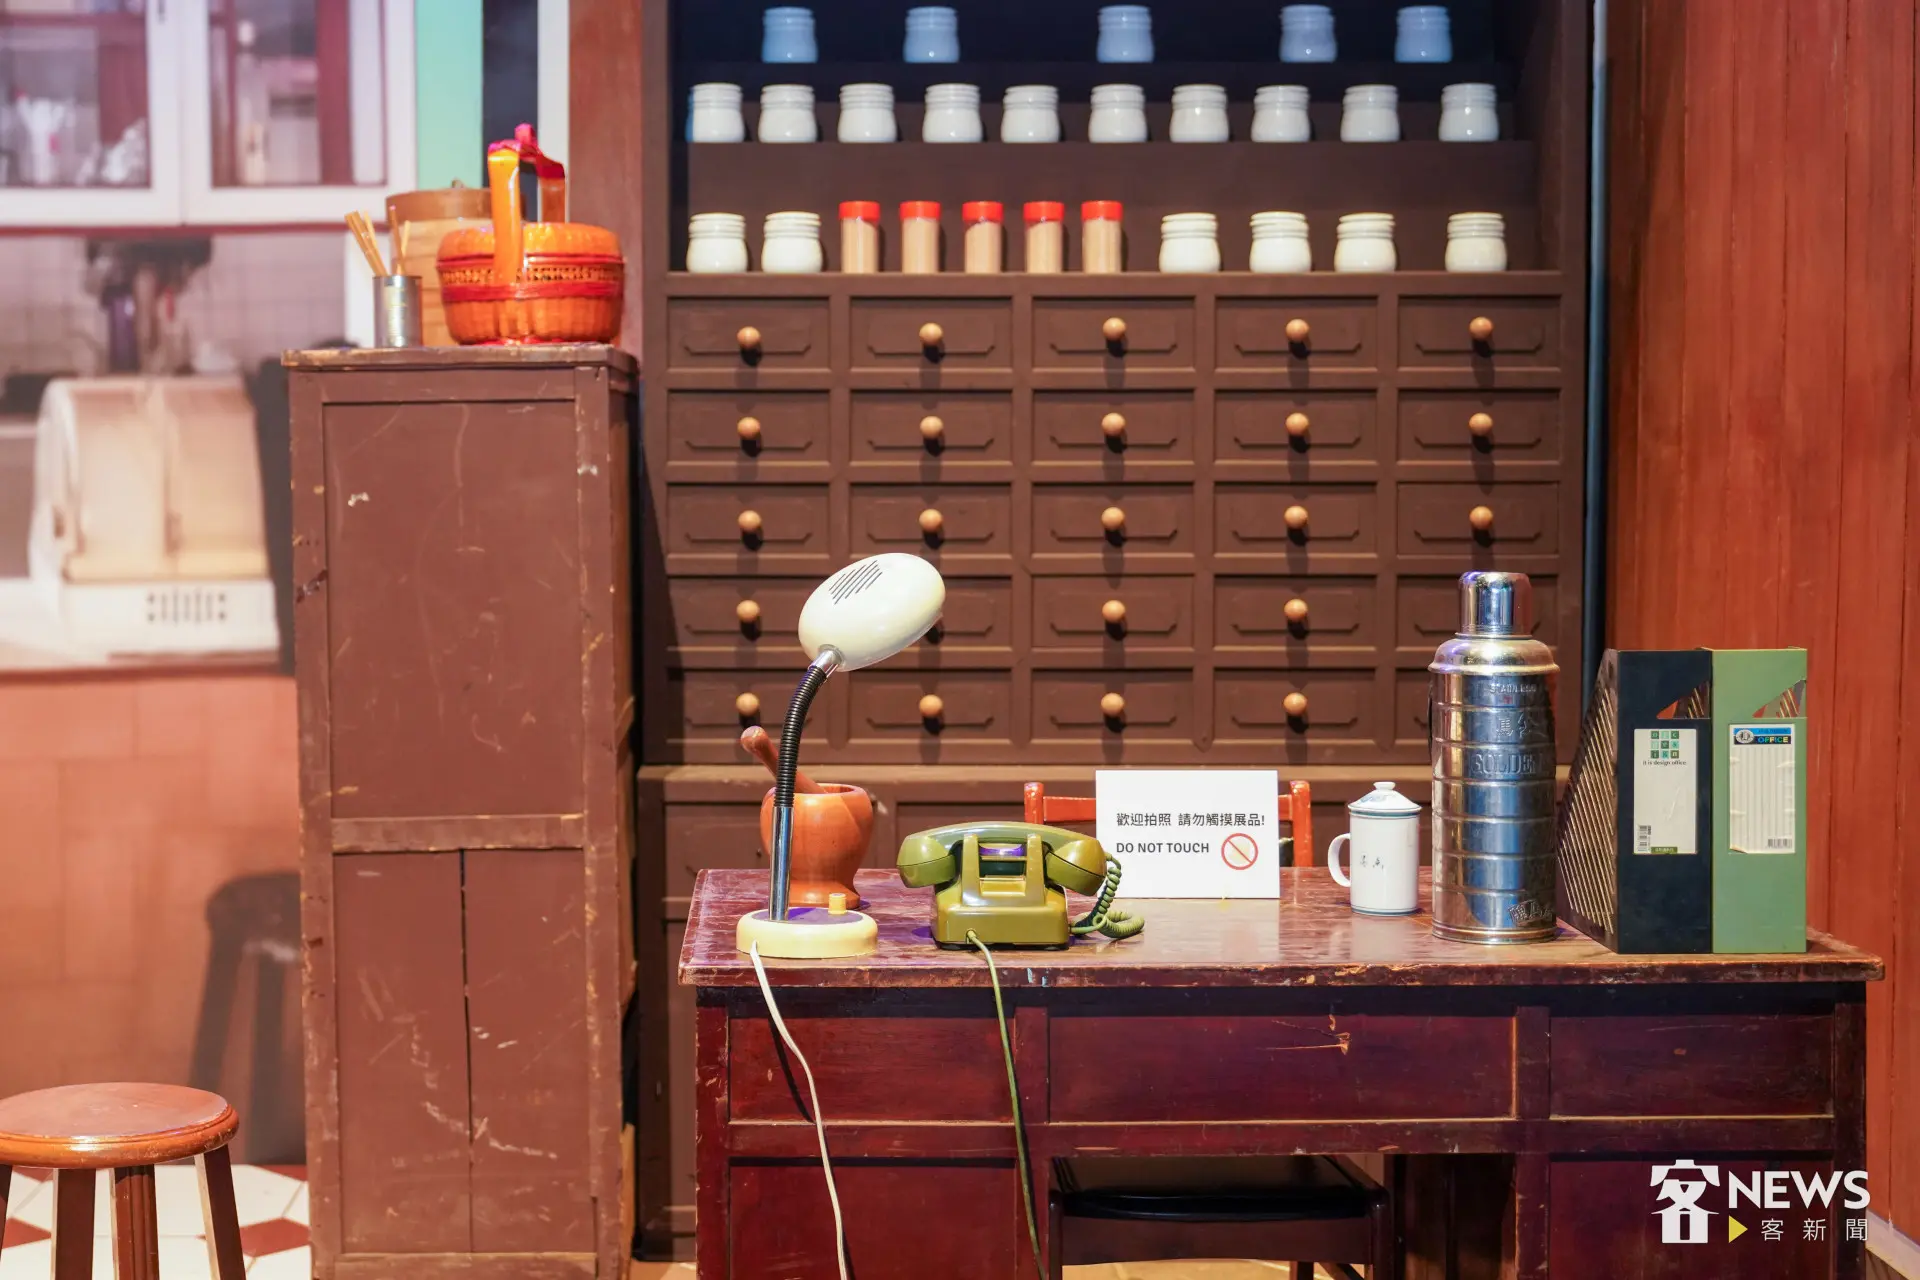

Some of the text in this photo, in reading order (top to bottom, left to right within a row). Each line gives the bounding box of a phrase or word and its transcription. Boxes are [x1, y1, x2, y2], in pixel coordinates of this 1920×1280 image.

[1116, 812, 1265, 827] 歡迎拍照 請勿觸摸展品!
[1116, 842, 1210, 853] DO NOT TOUCH
